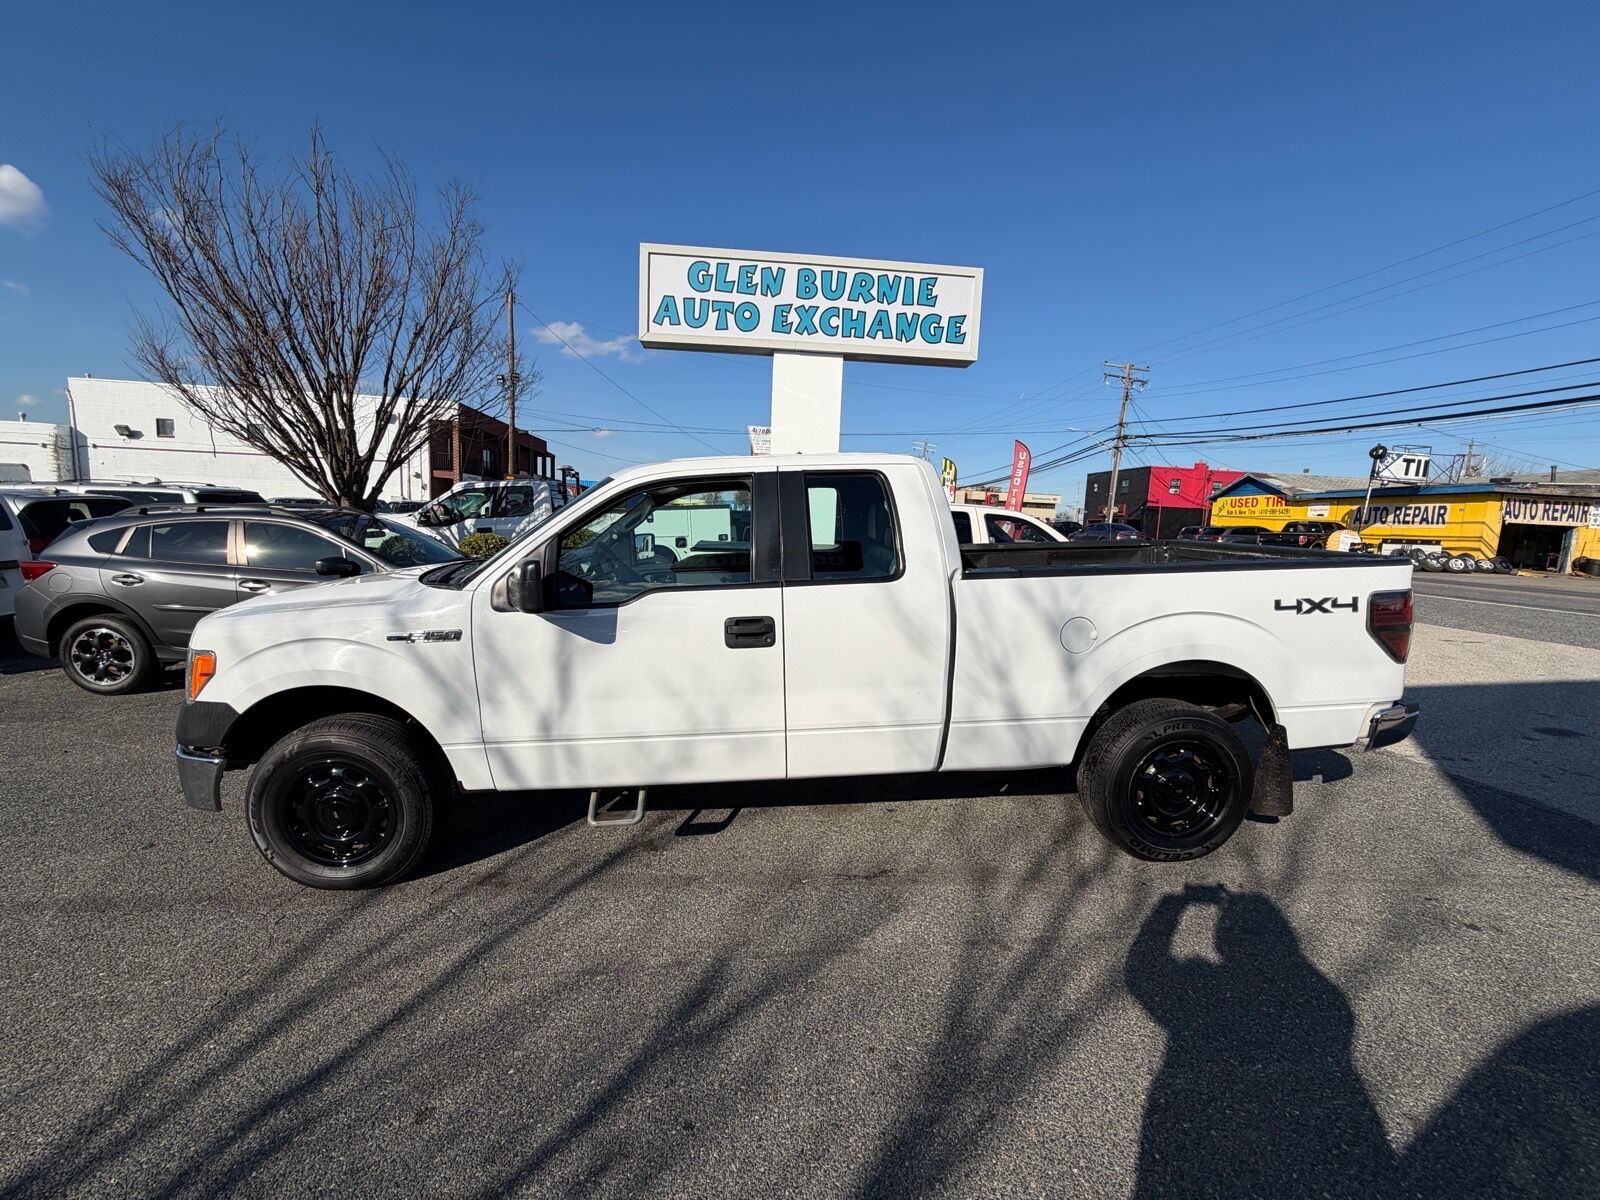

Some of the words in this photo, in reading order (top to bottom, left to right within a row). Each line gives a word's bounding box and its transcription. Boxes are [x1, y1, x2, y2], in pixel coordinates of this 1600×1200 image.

[687, 261, 786, 298] GLEN
[796, 268, 939, 308] BURNIE
[653, 295, 761, 332] AUTO
[771, 303, 968, 345] EXCHANGE
[1230, 497, 1259, 509] USED
[1505, 497, 1538, 521] AUTO
[1542, 500, 1590, 523] REPAIR
[1353, 506, 1390, 524] AUTO
[1393, 505, 1448, 525] REPAIR
[1274, 596, 1359, 615] 4X4
